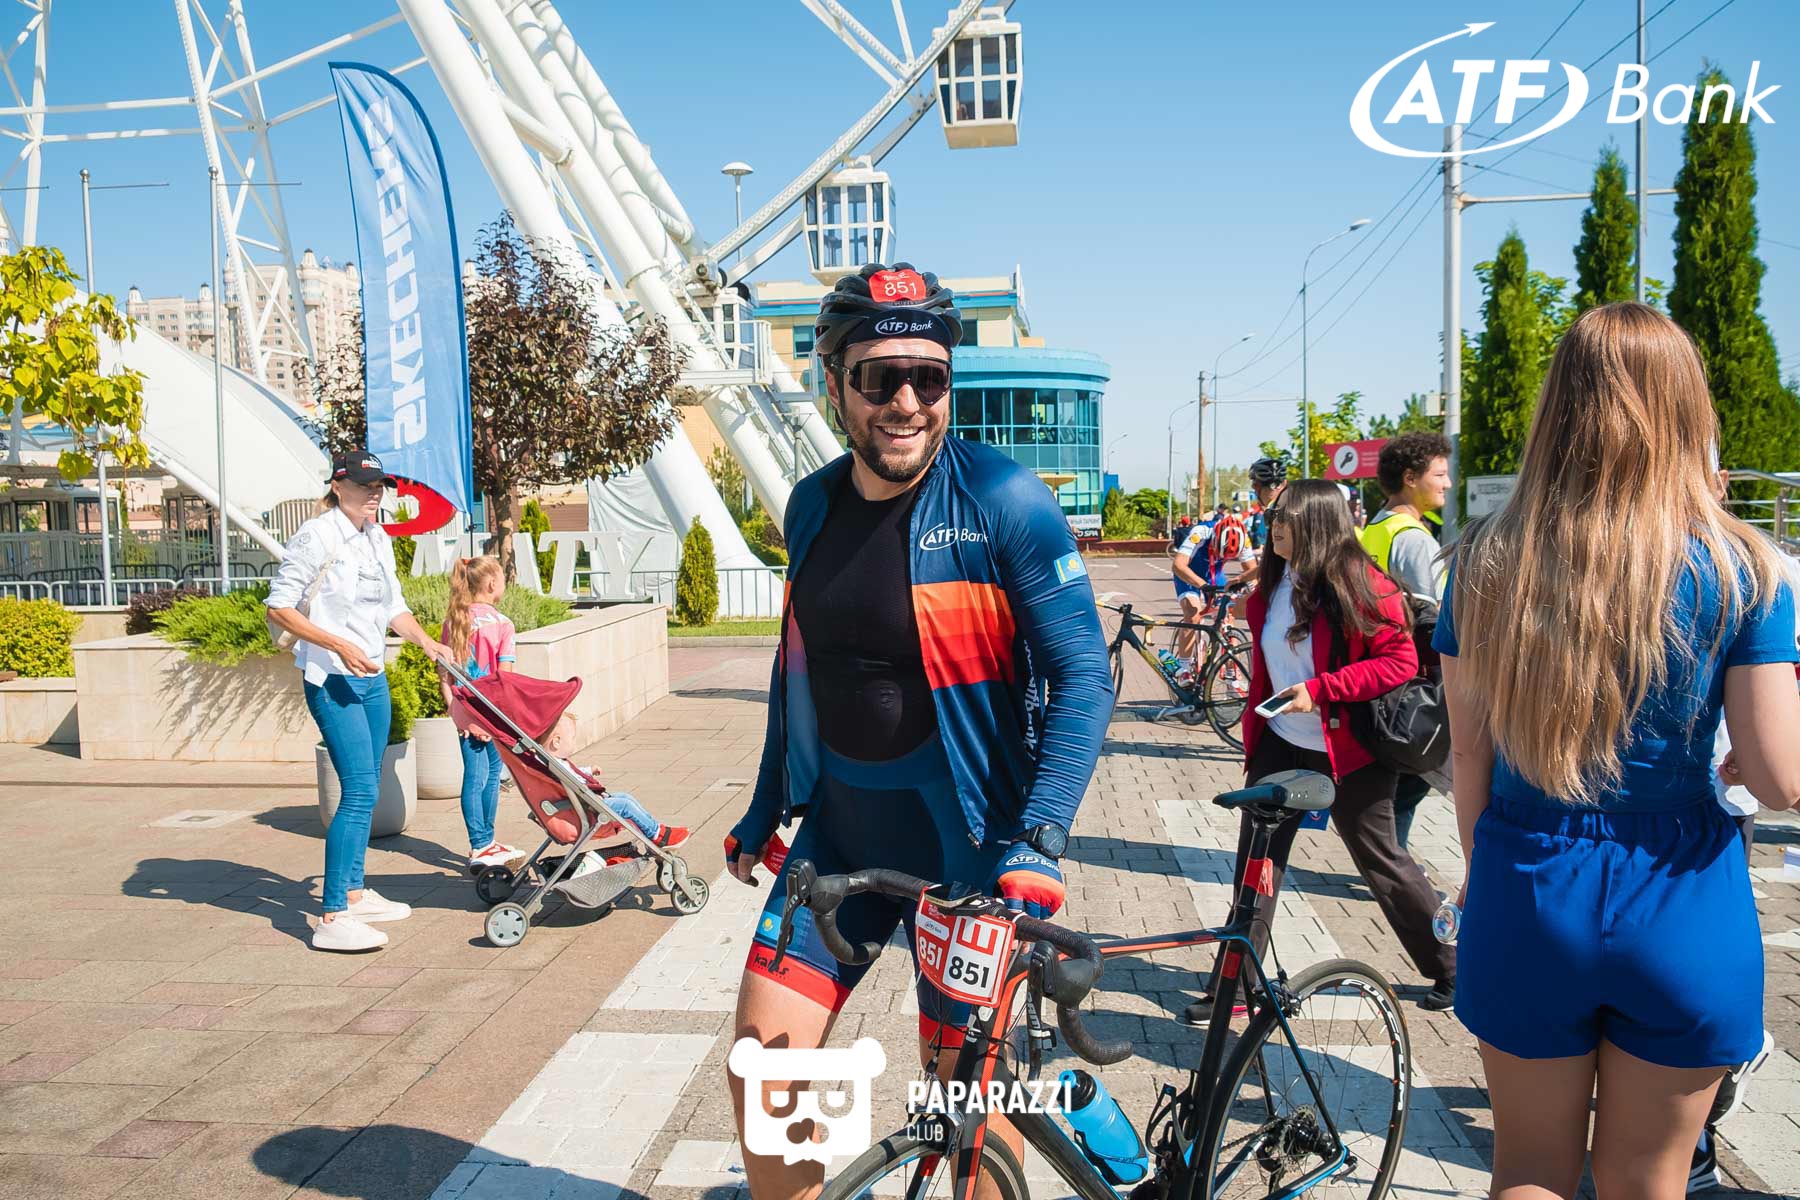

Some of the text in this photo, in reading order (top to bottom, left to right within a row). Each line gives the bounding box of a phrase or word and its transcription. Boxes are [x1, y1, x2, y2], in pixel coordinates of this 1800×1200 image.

[884, 281, 917, 297] 851
[880, 320, 933, 332] ATF Bank
[925, 528, 954, 546] ATF
[919, 936, 943, 970] 851
[754, 953, 790, 975] kas
[948, 956, 990, 989] 851
